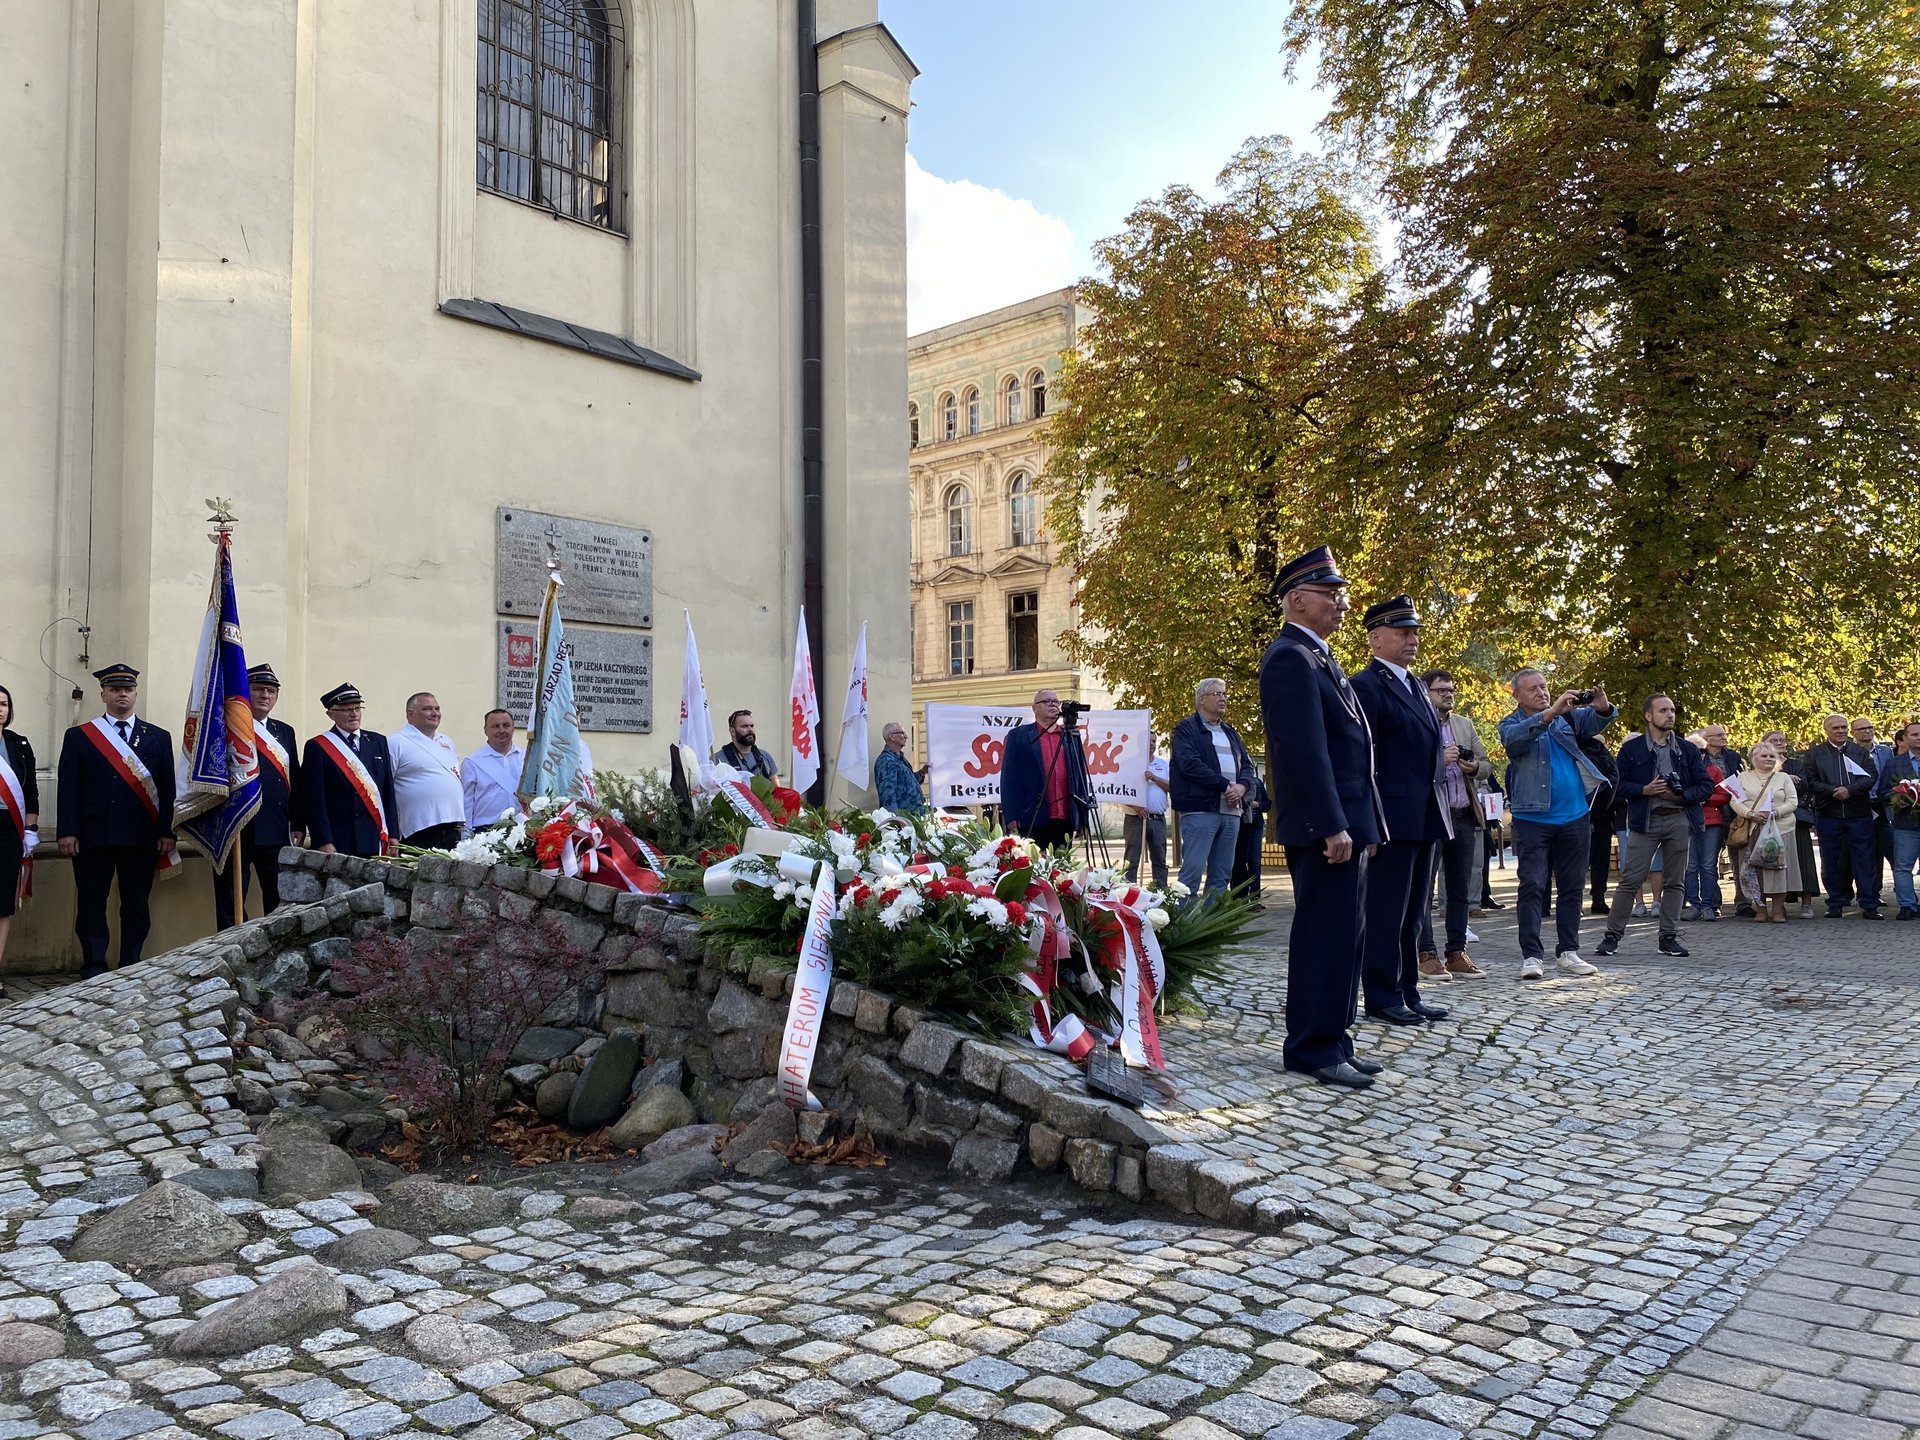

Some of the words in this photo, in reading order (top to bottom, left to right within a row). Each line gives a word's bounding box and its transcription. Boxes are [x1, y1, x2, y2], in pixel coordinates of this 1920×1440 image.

[574, 660, 583, 669] RP
[583, 661, 603, 672] LECHA
[506, 670, 520, 678] JEGO
[982, 714, 1024, 728] NSZZ
[783, 987, 821, 1110] OHATEROM
